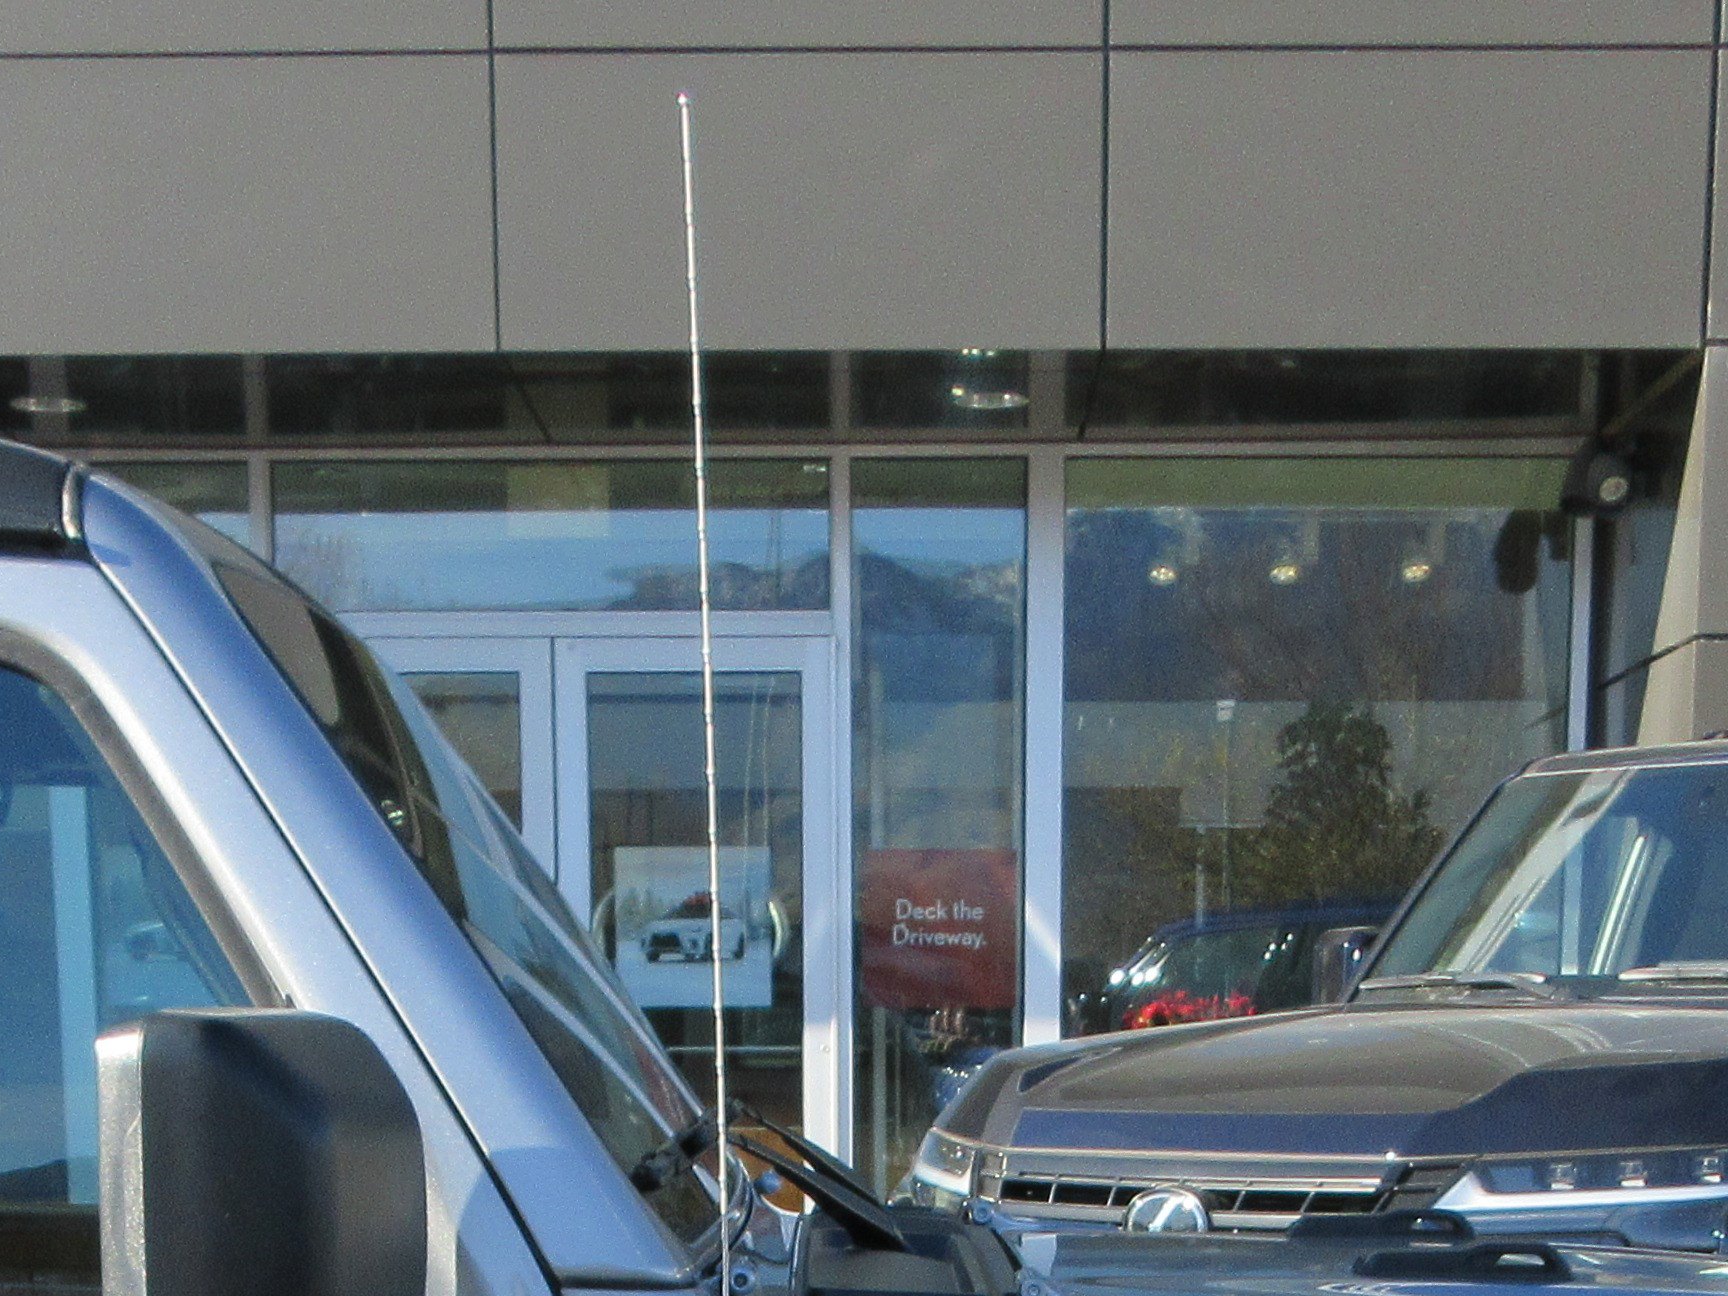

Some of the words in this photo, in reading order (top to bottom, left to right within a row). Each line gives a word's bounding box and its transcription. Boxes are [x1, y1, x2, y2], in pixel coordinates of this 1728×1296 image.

[895, 898, 947, 920] Deck
[954, 899, 985, 920] the
[893, 923, 988, 949] Driveway.
